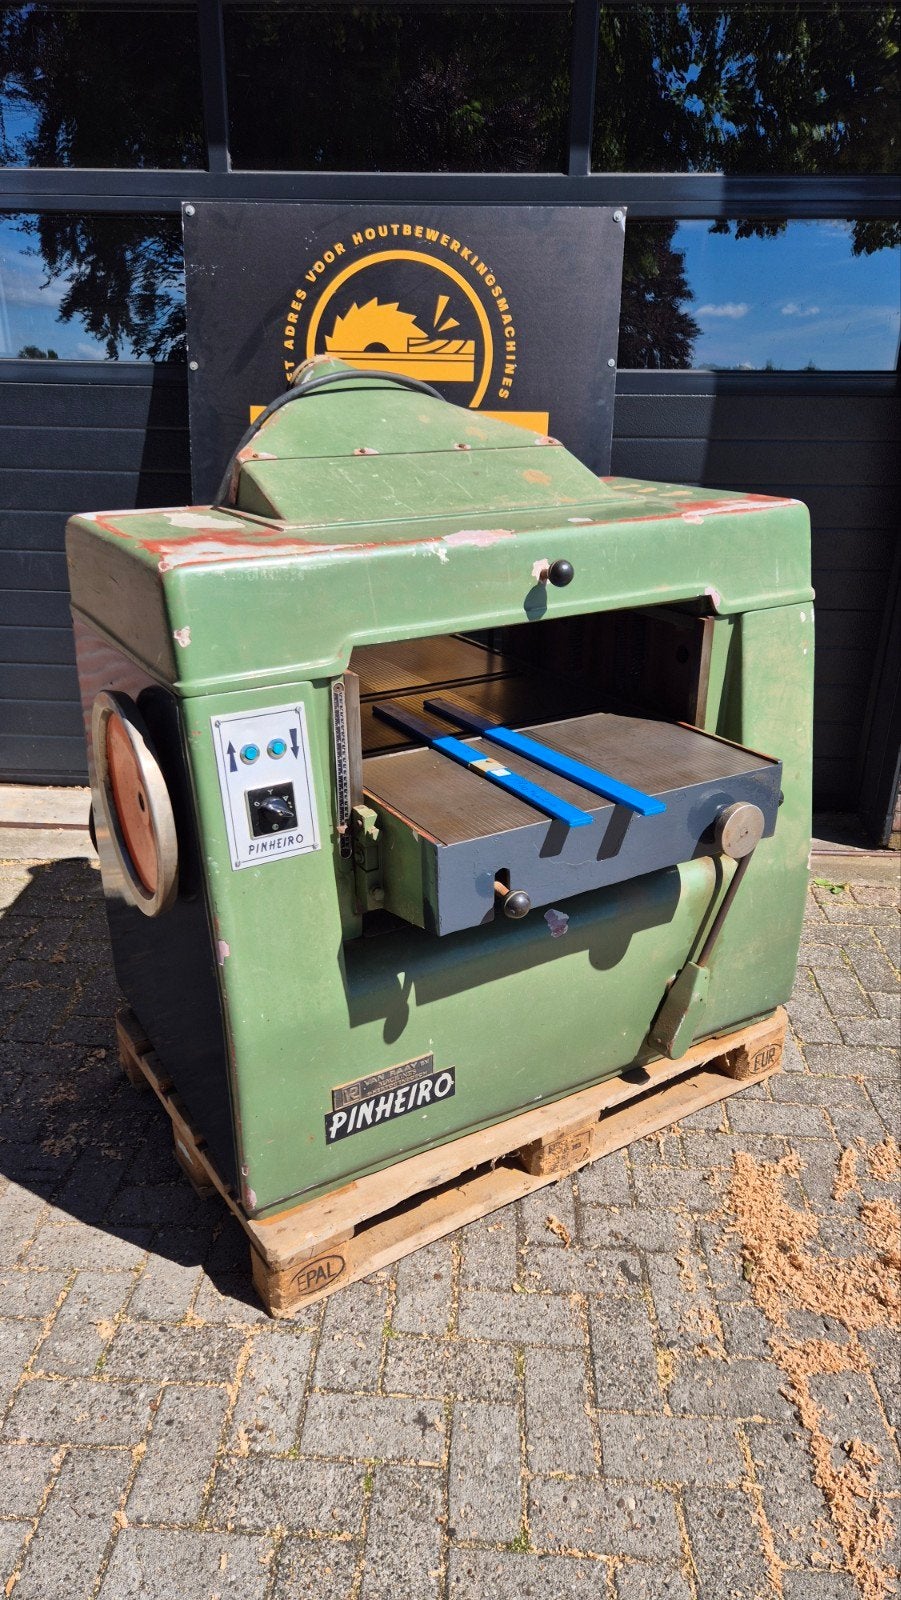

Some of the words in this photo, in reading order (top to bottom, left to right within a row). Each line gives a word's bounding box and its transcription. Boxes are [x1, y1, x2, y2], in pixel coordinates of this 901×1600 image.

[284, 289, 307, 350] ADRES
[305, 242, 346, 283] VOOR
[352, 223, 516, 399] HOUTBEWERKINGSMACHINES
[248, 834, 304, 855] PINHEIRO
[753, 1047, 776, 1072] EUR
[364, 1073, 386, 1087] VAN
[329, 1072, 454, 1139] PINHEIRO
[297, 1261, 338, 1293] EPAL
